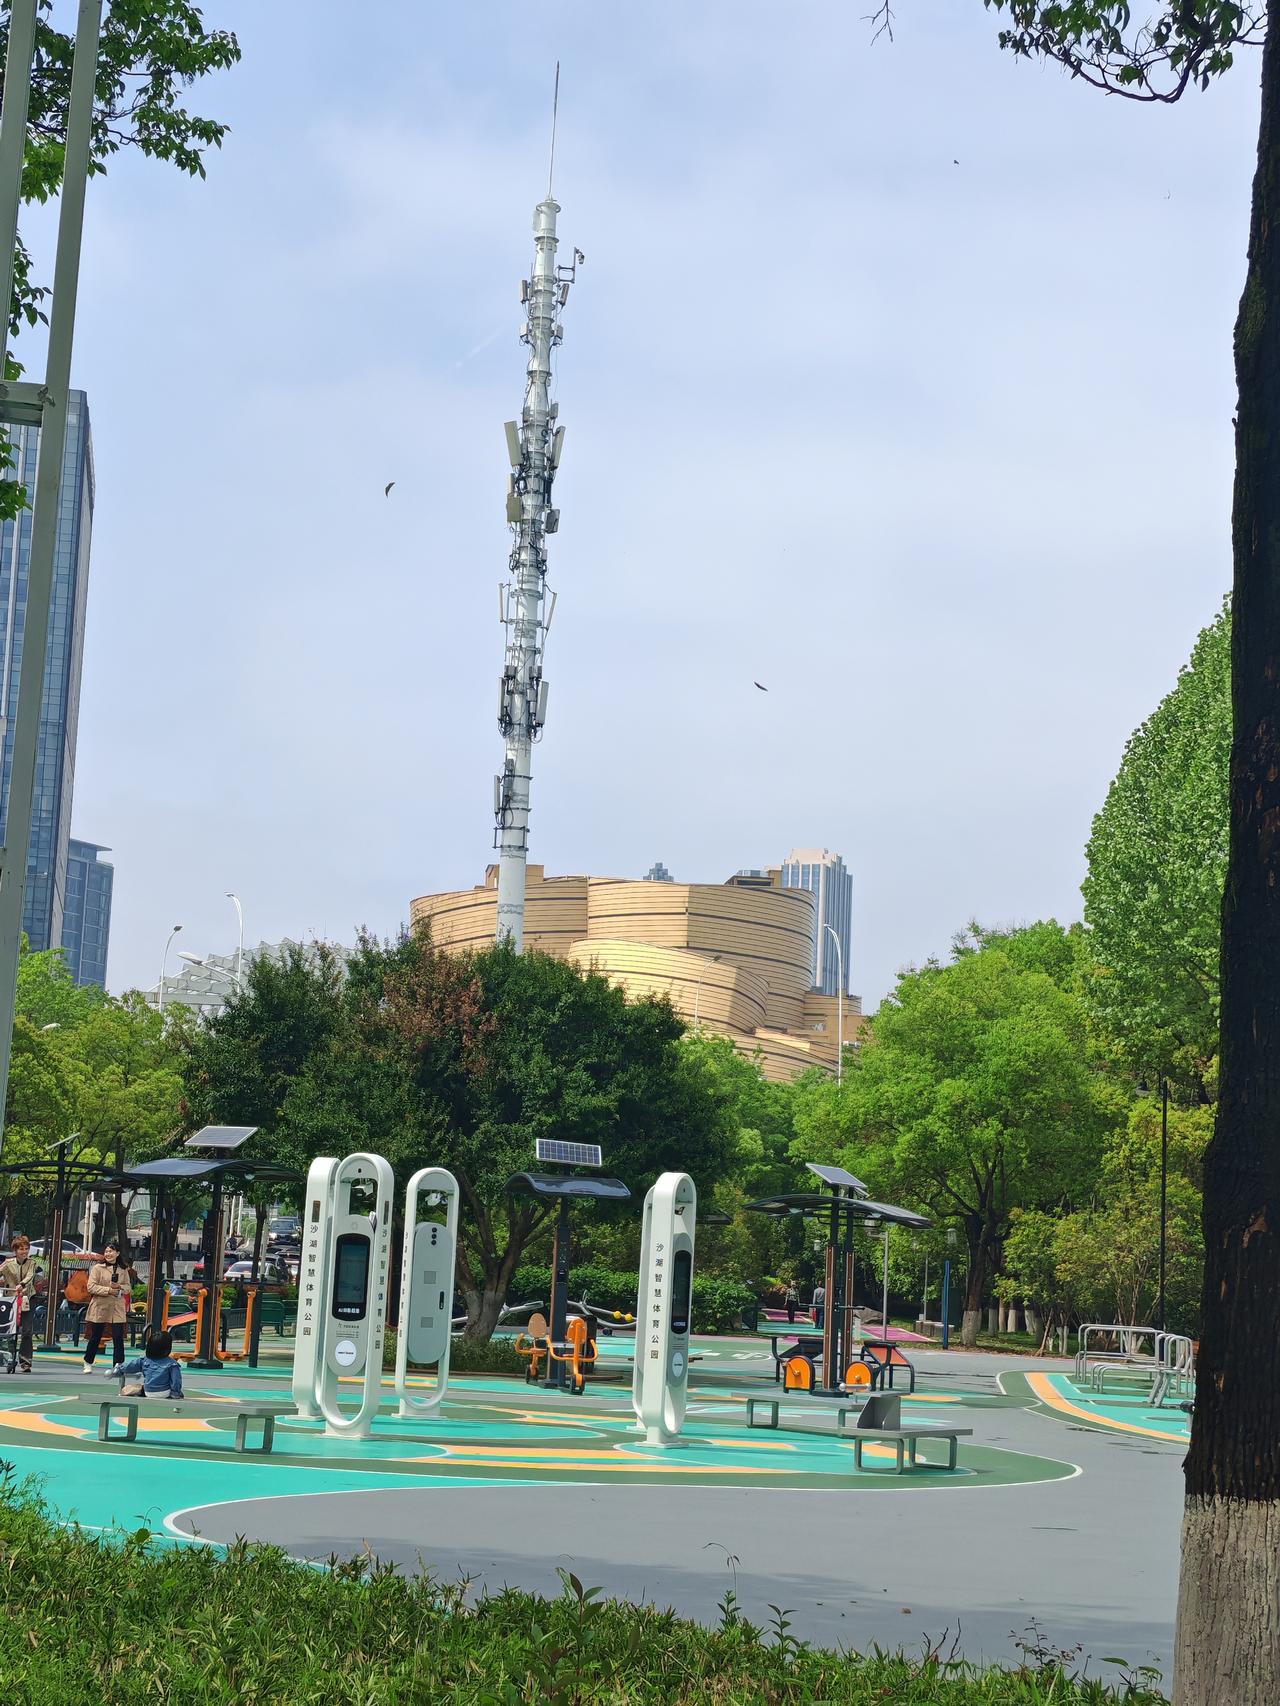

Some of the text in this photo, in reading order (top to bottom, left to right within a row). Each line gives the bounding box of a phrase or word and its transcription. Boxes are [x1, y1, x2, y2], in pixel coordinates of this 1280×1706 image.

[303, 1225, 319, 1336] 沙湖智慧体育公园
[650, 1243, 664, 1359] 沙湖智慧体育公园
